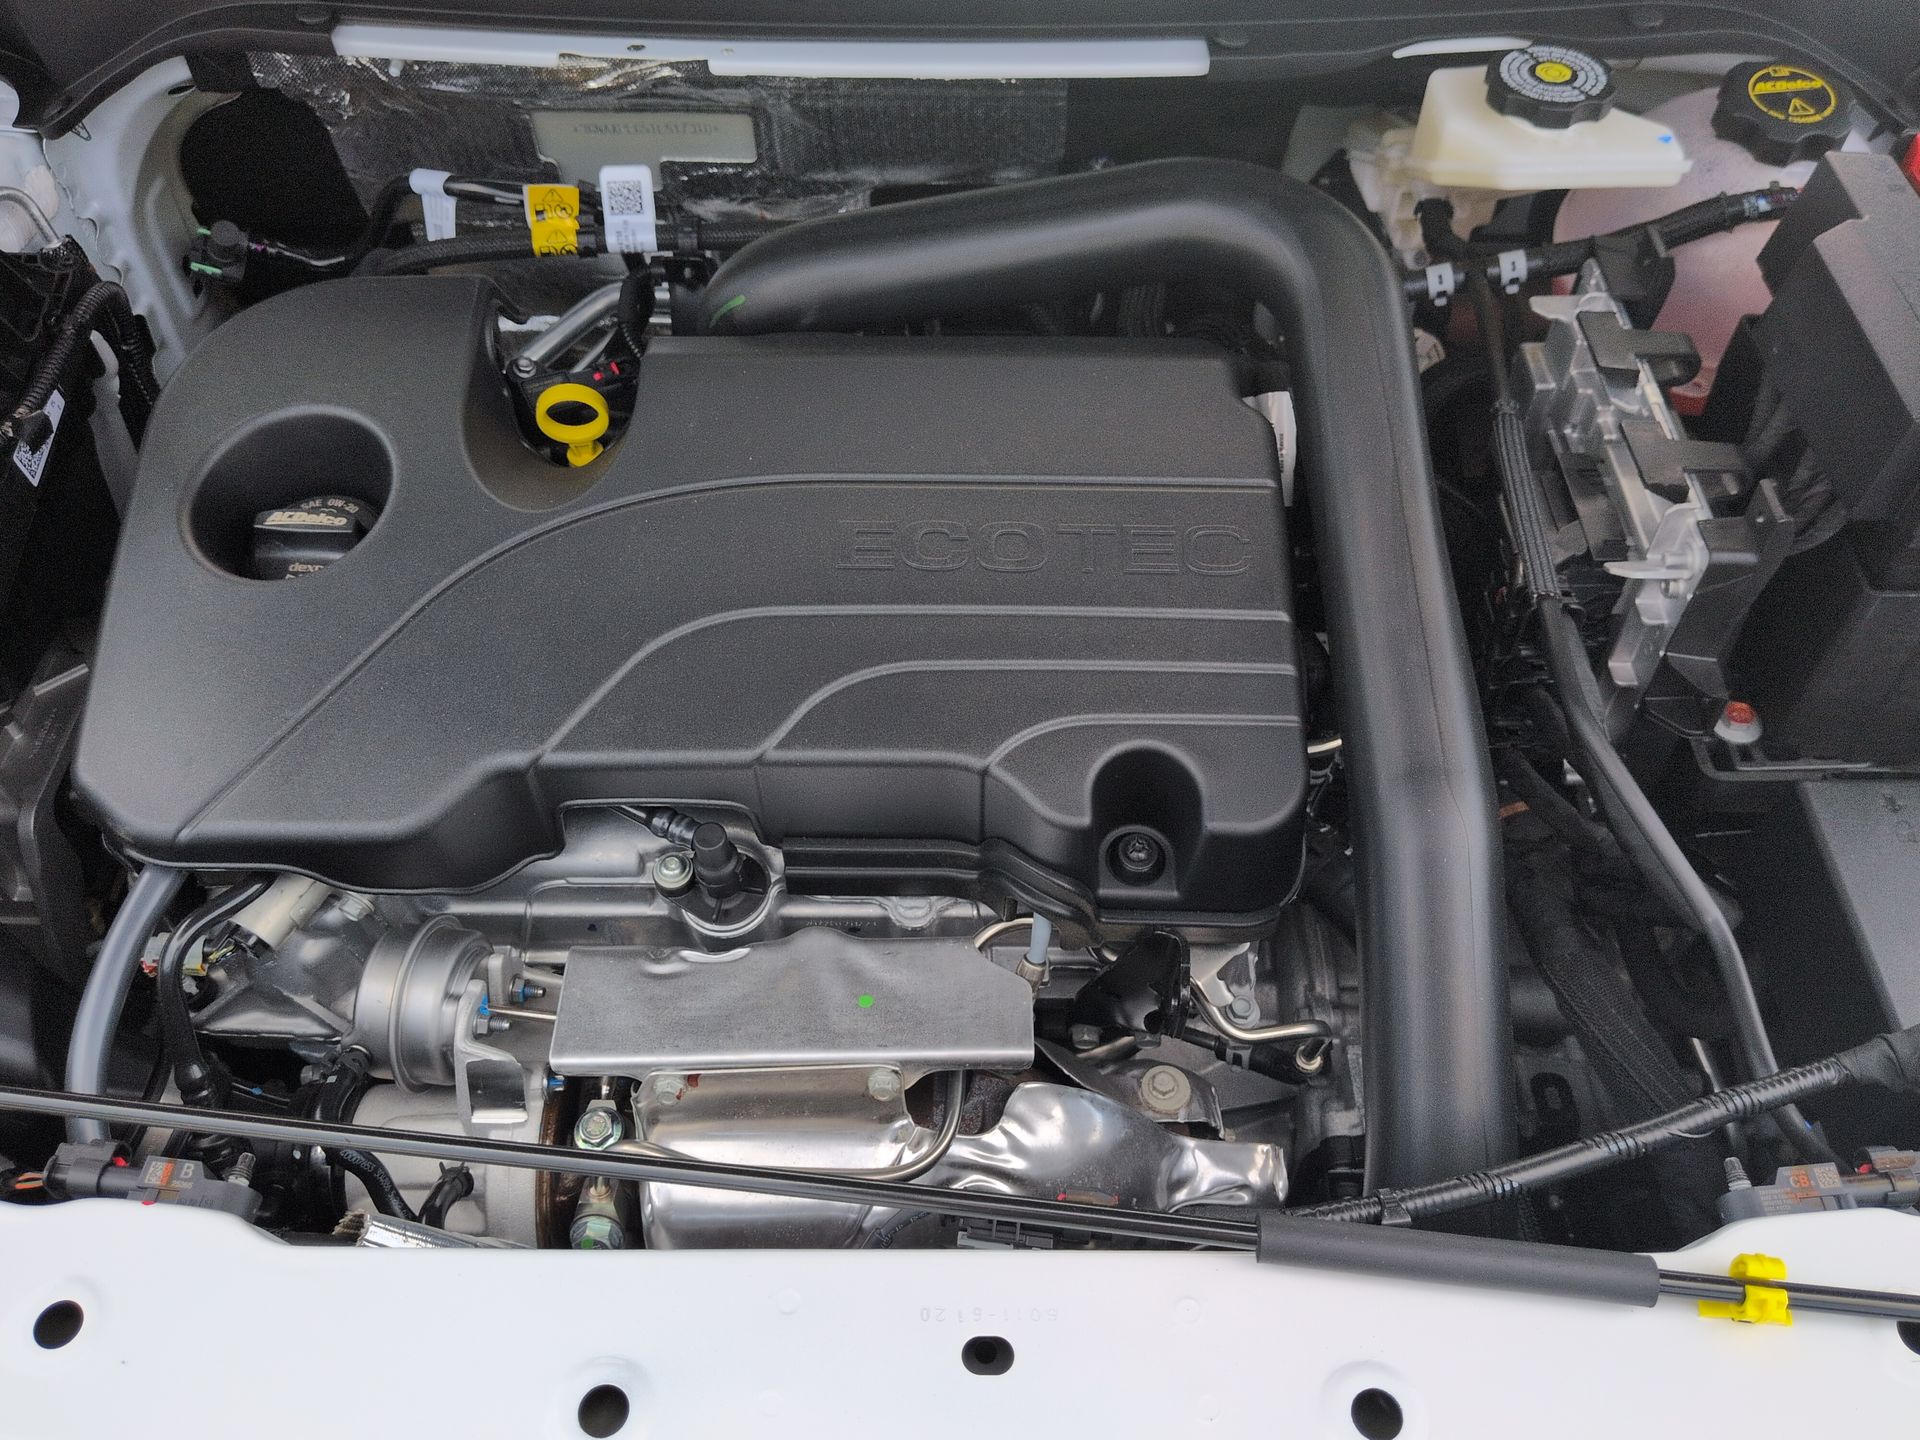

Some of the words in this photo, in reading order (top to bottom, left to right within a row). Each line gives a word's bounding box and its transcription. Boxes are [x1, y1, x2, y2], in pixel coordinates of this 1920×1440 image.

[301, 499, 323, 510] SAE
[327, 498, 359, 513] 0W-20
[264, 511, 348, 526] ACDelco
[836, 520, 1252, 576] ECOTEC
[181, 1162, 194, 1179] B
